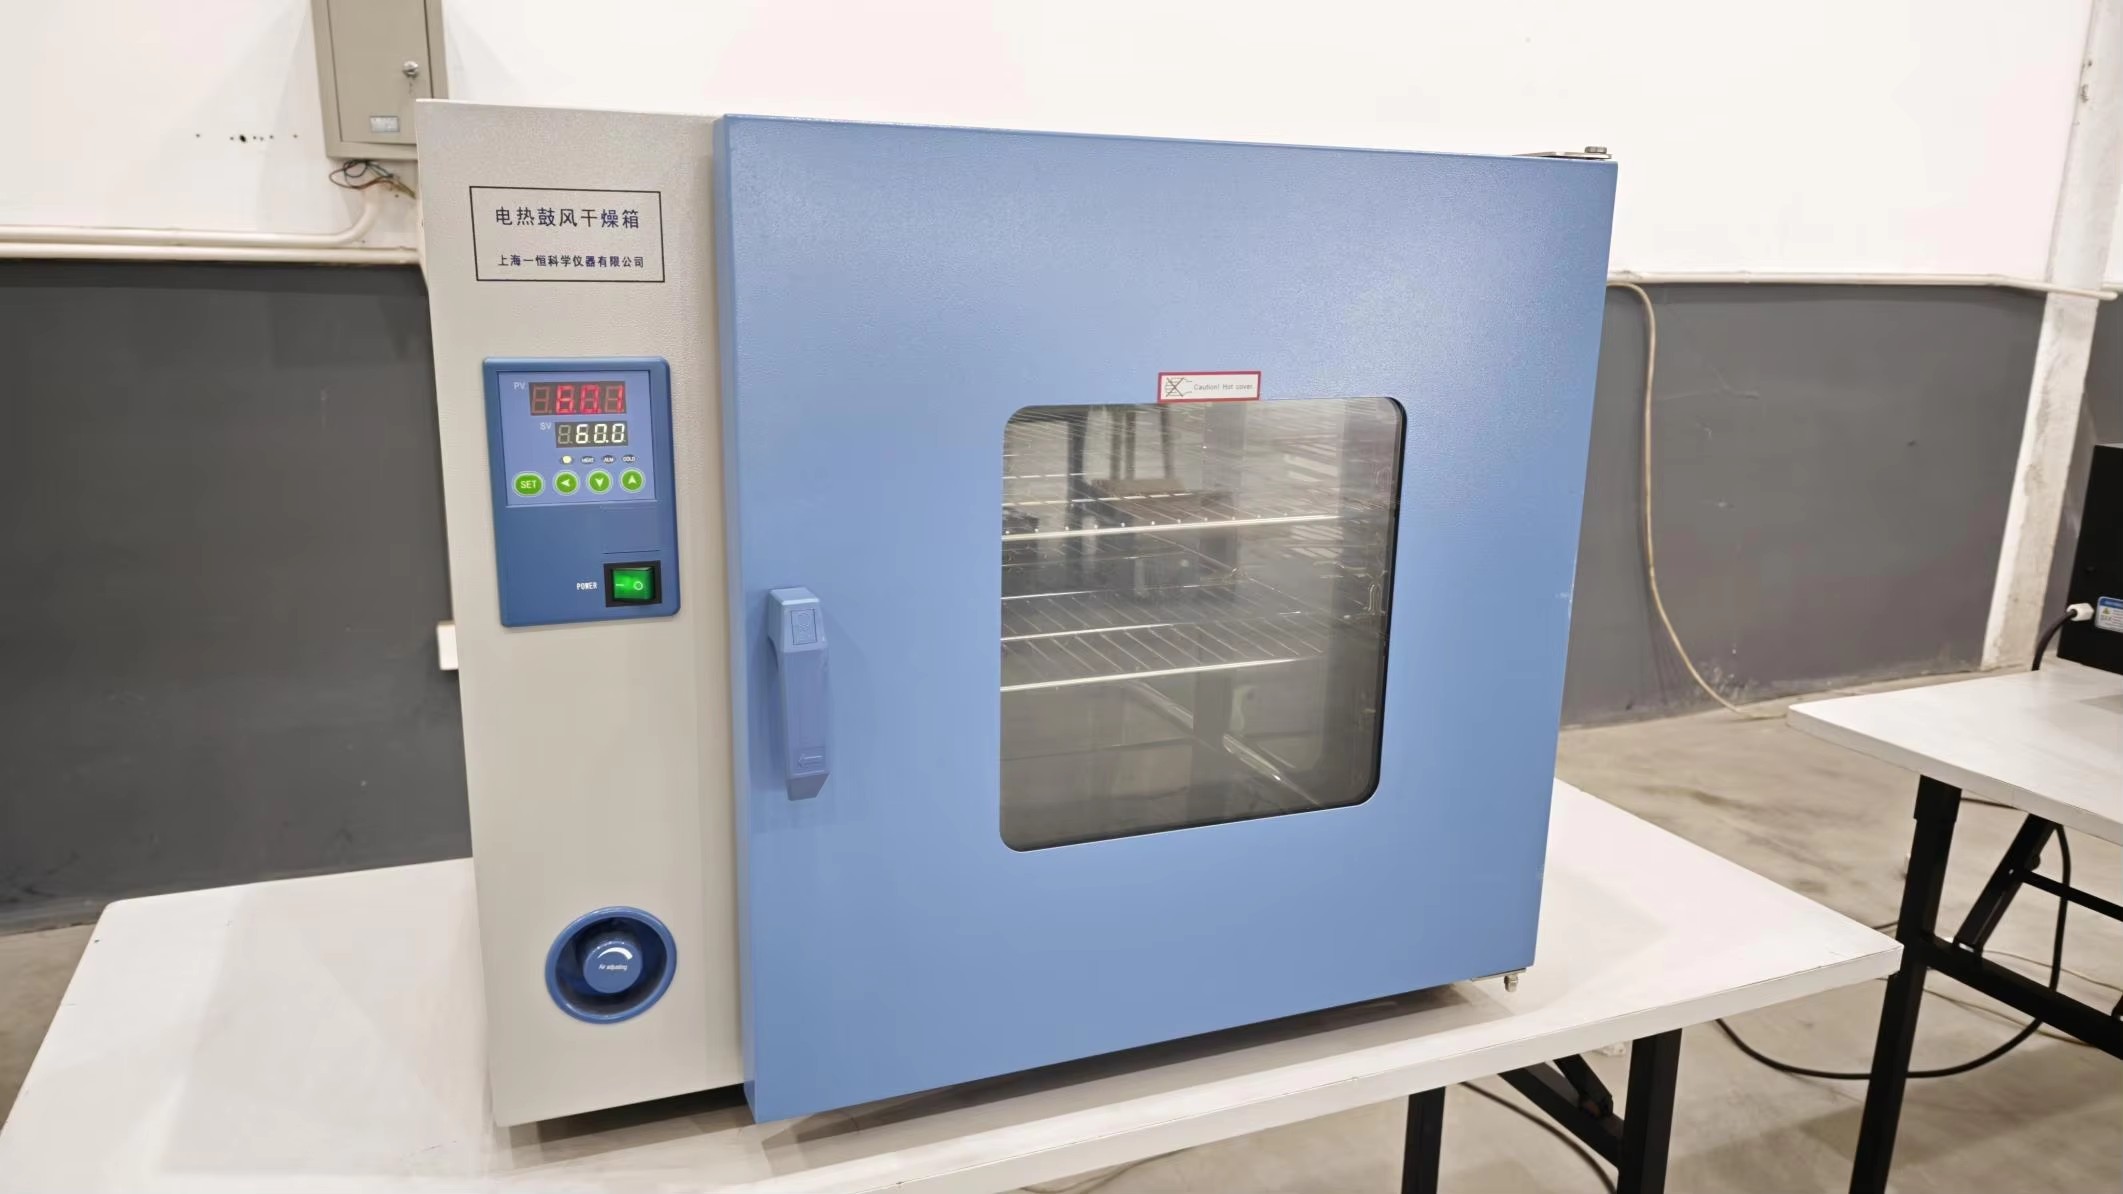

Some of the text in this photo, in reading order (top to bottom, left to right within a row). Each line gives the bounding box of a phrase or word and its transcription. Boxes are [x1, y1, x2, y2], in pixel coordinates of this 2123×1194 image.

[495, 207, 640, 229] 电热鼓风干燥箱
[498, 254, 645, 268] 上海一恒科学仪器有限公司
[513, 382, 526, 390] PV
[540, 422, 552, 431] SV
[575, 423, 626, 444] 60.0
[520, 480, 537, 489] SET
[576, 581, 598, 591] POWER
